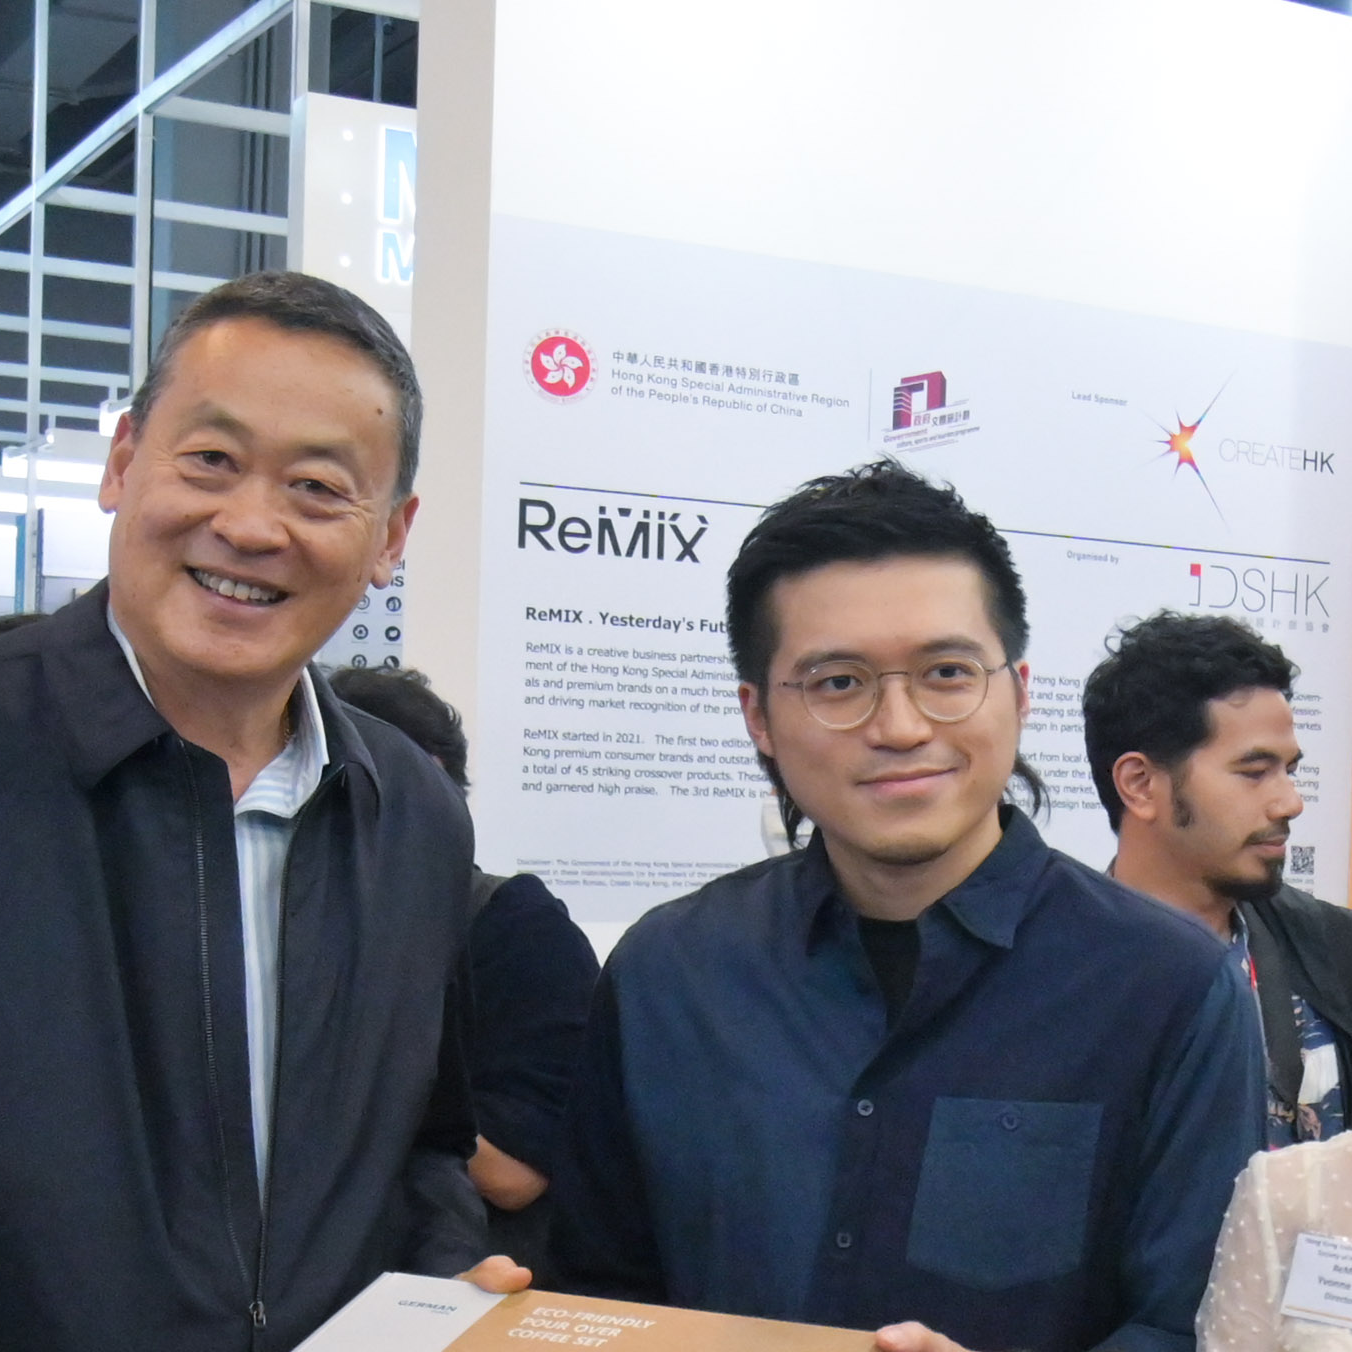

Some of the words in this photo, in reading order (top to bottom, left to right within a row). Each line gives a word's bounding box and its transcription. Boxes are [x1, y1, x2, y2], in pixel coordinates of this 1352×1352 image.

[611, 369, 643, 386] Hong
[647, 373, 677, 389] Kong
[681, 377, 724, 393] Special
[727, 382, 808, 402] Administrative
[811, 393, 850, 409] Region
[1071, 391, 1092, 402] Lead
[1095, 394, 1128, 406] Sponsor
[611, 385, 622, 395] of
[626, 387, 645, 398] the
[649, 389, 698, 406] People's
[702, 396, 752, 412] Republic
[756, 402, 767, 412] of
[770, 403, 803, 417] China
[1219, 438, 1334, 474] CREATEHK
[1067, 550, 1109, 563] Organised
[1111, 554, 1119, 565] by
[525, 606, 583, 623] ReMIX
[599, 612, 694, 634] Yesterday's
[526, 642, 561, 654] ReMIX
[565, 644, 574, 655] is
[577, 647, 583, 656] a
[587, 646, 629, 658] creative
[633, 648, 676, 661] business
[525, 662, 553, 672] ment
[557, 662, 567, 673] of
[570, 663, 588, 674] the
[592, 664, 619, 679] Hong
[623, 665, 648, 681] Kong
[652, 667, 687, 682] Special
[1033, 675, 1055, 687] Hong
[1059, 677, 1080, 687] Kong
[525, 678, 540, 689] als
[543, 679, 563, 690] and
[567, 681, 613, 694] premium
[617, 682, 652, 694] brands
[656, 686, 668, 695] on
[671, 687, 677, 695] a
[681, 686, 708, 697] much
[524, 695, 544, 706] and
[549, 695, 584, 711] driving
[589, 698, 625, 709] market
[629, 700, 686, 714] recognition
[690, 702, 701, 713] of
[704, 702, 720, 714] the
[524, 728, 558, 740] ReMIX
[562, 730, 599, 742] started
[603, 731, 612, 742] in
[616, 732, 645, 744] 2021.
[655, 733, 674, 745] The
[678, 734, 697, 745] first
[701, 735, 718, 746] two
[523, 746, 550, 761] Kong
[554, 748, 601, 762] premium
[605, 751, 655, 761] consumer
[659, 751, 693, 763] brands
[697, 753, 715, 764] and
[522, 767, 529, 775] a
[533, 765, 557, 776] total
[561, 766, 571, 777] of
[575, 766, 589, 777] 45
[593, 767, 630, 782] striking
[634, 771, 682, 780] crossover
[687, 770, 733, 784] products.
[522, 781, 542, 791] and
[546, 782, 594, 796] garnered
[598, 783, 620, 798] high
[624, 784, 658, 798] praise.
[671, 785, 689, 796] The
[693, 786, 709, 797] 3rd
[713, 787, 745, 798] ReMIX
[749, 788, 756, 799] is
[398, 1300, 458, 1312] GERMAN
[520, 1317, 570, 1330] POUR
[573, 1324, 623, 1337] OVER
[532, 1307, 657, 1329] ECO-FRIENDLY
[507, 1328, 572, 1343] COFFEE
[572, 1336, 608, 1347] SET
